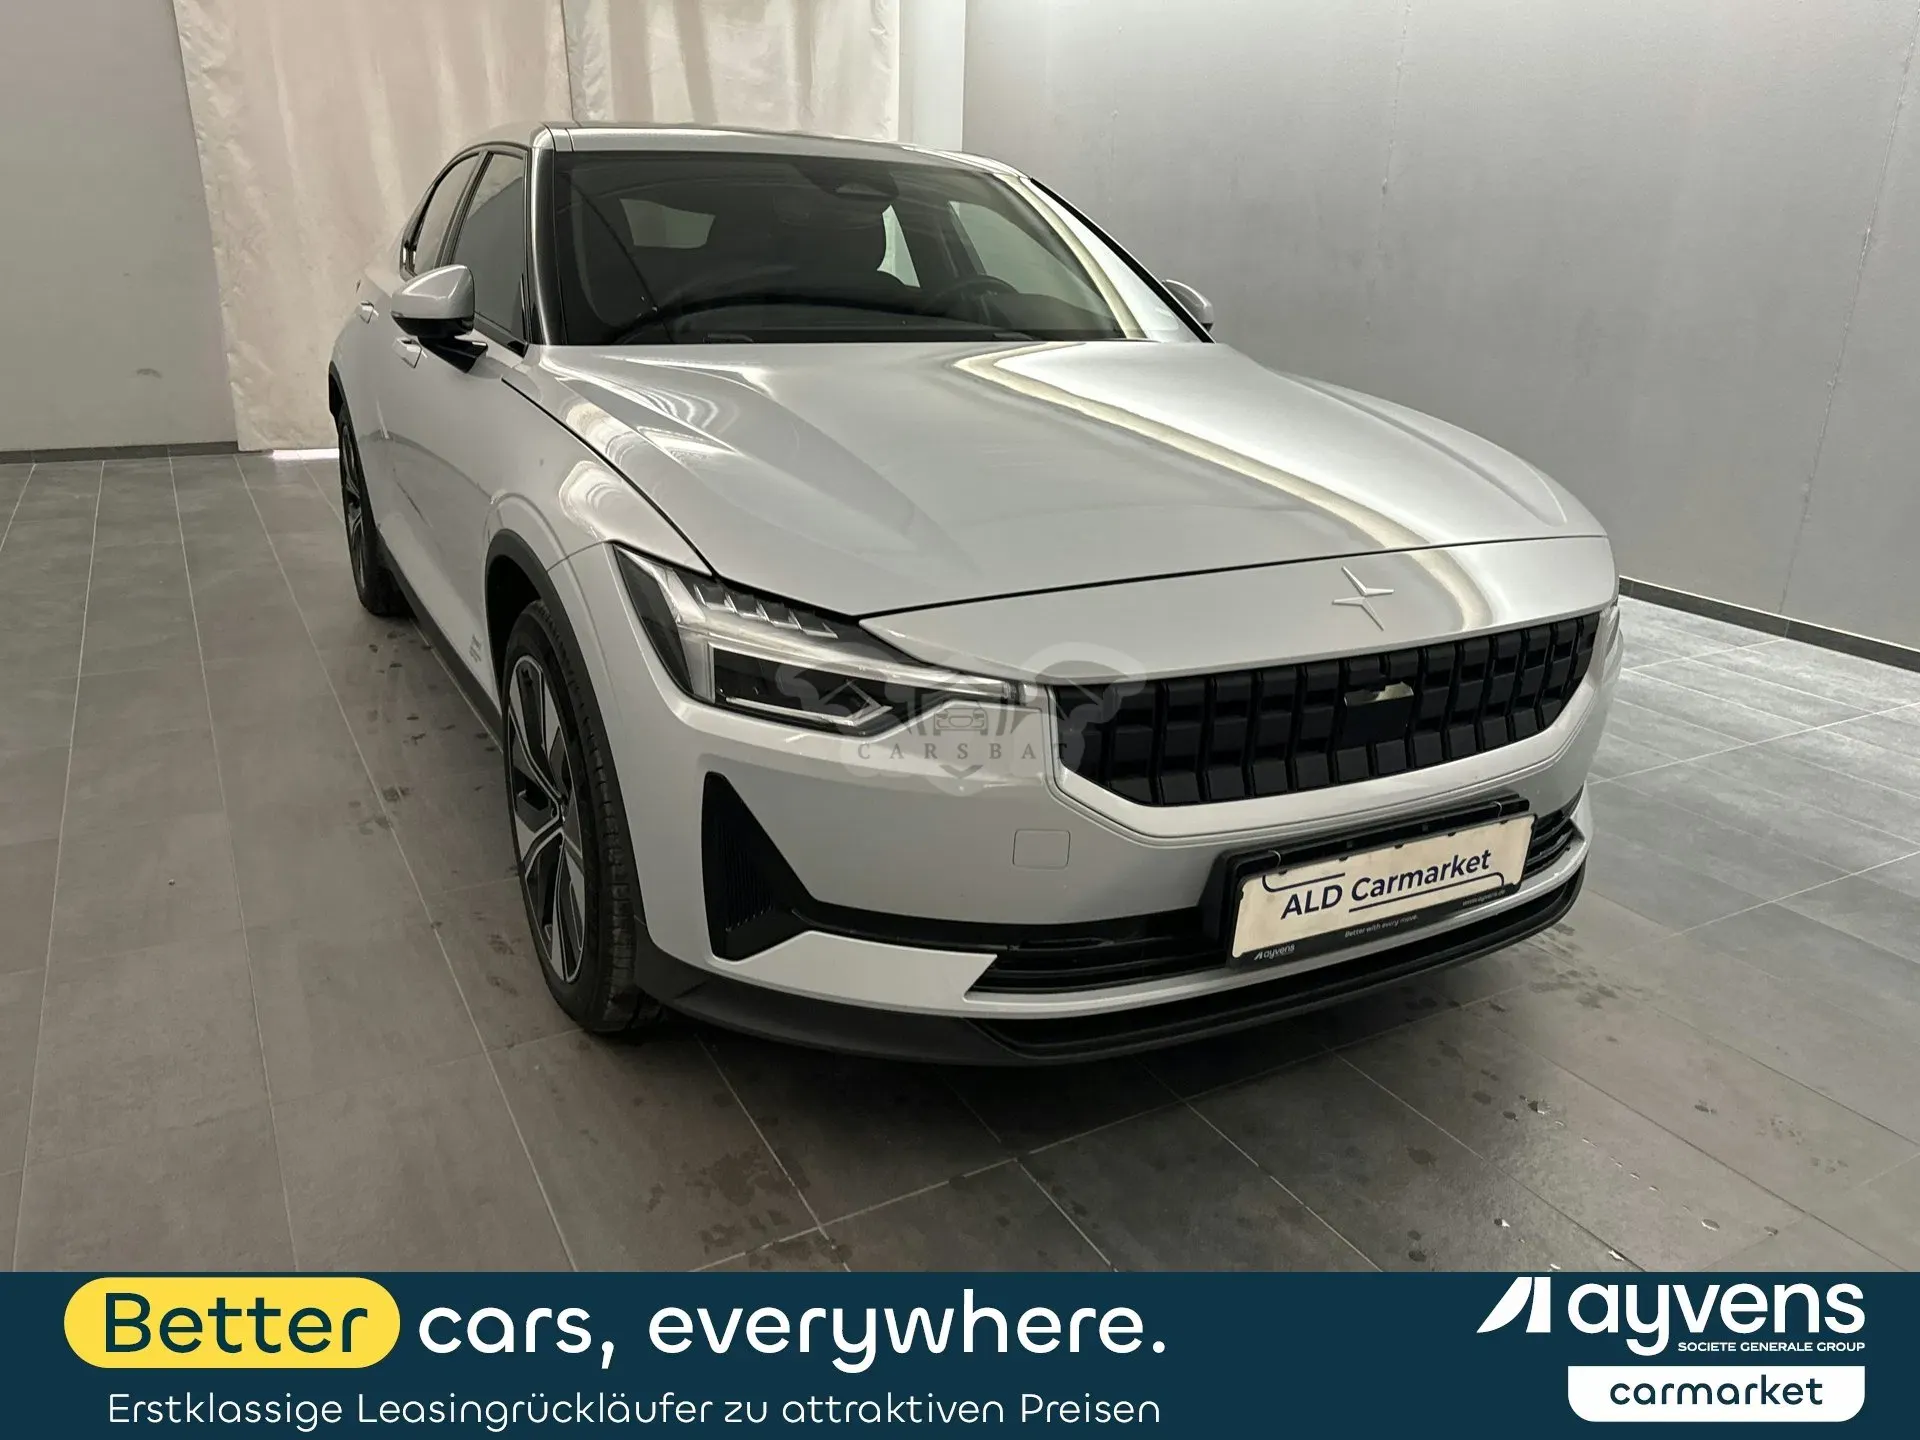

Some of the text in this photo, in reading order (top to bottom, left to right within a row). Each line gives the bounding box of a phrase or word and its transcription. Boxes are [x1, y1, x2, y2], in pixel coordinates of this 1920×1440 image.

[1281, 849, 1492, 920] ALD Carmarket
[1366, 923, 1381, 933] with
[1263, 944, 1295, 959] ayvens
